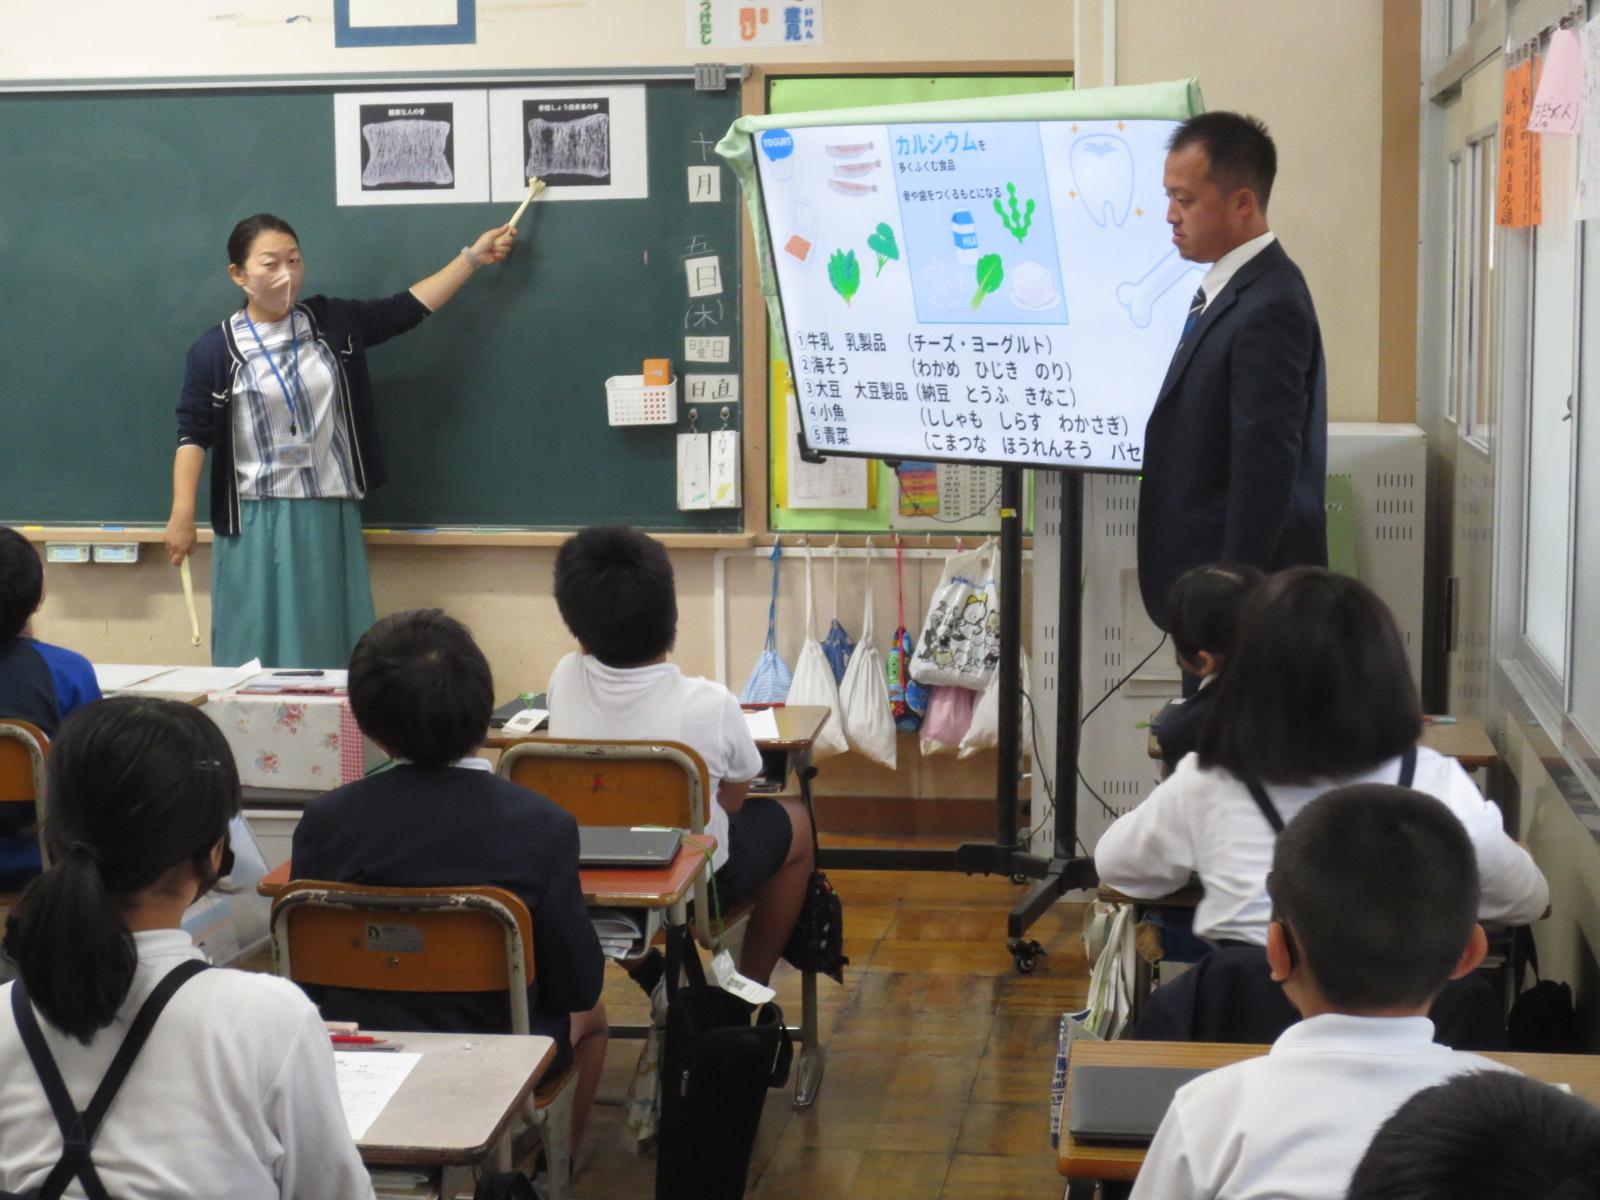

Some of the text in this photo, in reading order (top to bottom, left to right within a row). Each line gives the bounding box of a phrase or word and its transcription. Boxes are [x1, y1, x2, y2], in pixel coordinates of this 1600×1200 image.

[899, 159, 956, 173] 多くふくむ食品
[696, 173, 711, 196] 月
[903, 187, 1002, 202] 骨や歯をつくるもとになる
[696, 265, 717, 291] 日
[688, 339, 724, 359] 曜日
[845, 332, 887, 352] 乳製品
[975, 361, 1017, 380] ひじき
[692, 378, 735, 400] 日直
[854, 380, 909, 401] 大豆製品
[966, 385, 1009, 404] とうふ
[1000, 412, 1041, 430] しらす
[1003, 437, 1092, 459] ほうれんそう
